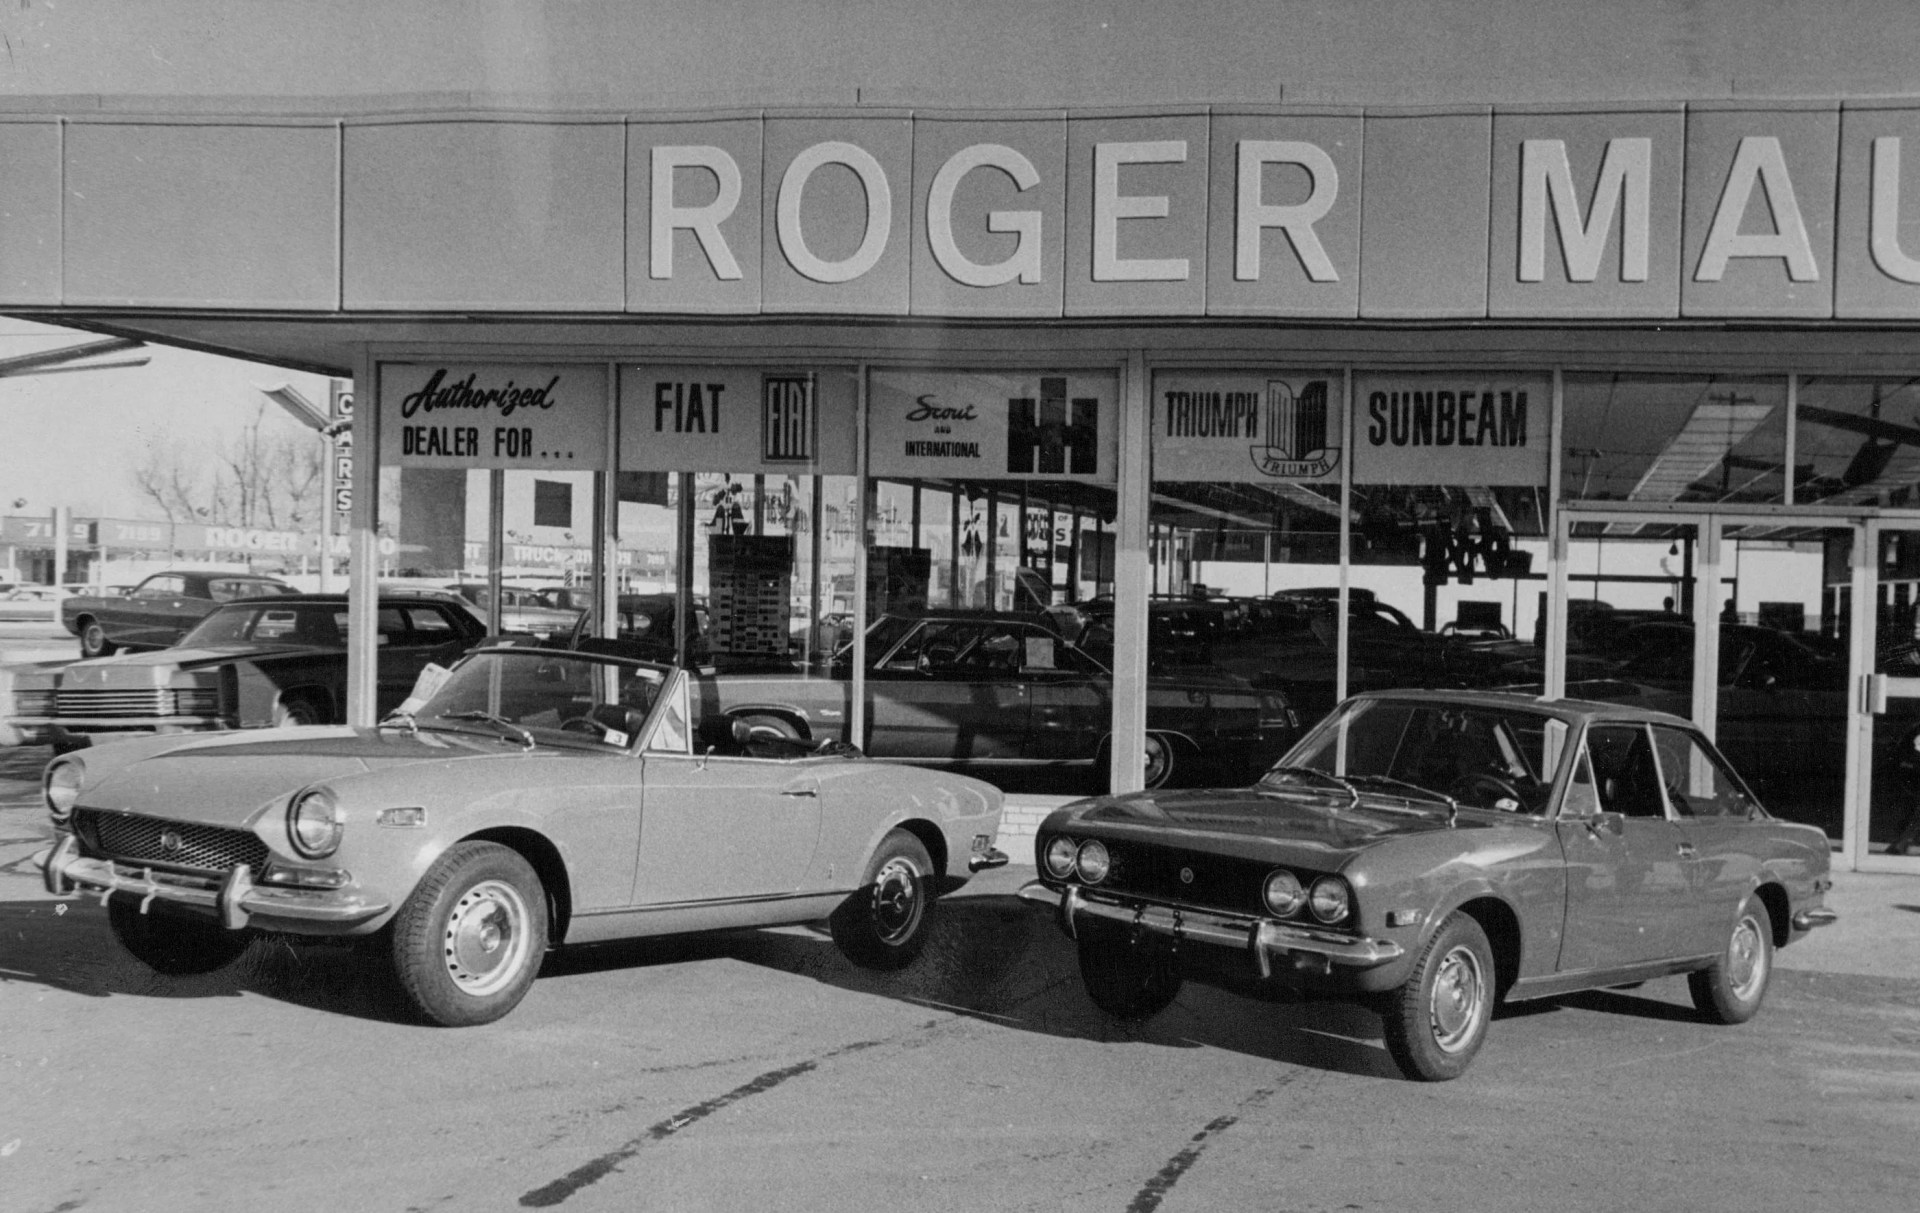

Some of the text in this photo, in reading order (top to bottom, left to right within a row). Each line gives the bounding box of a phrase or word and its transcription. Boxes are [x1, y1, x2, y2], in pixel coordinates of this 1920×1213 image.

[649, 138, 1343, 287] ROGER
[402, 368, 560, 419] Authorized
[655, 382, 725, 433] FIAT
[905, 394, 979, 421] Scout
[1164, 391, 1259, 438] TRIUMPH
[403, 425, 479, 457] DEALER
[767, 380, 814, 457] FIAT
[934, 426, 951, 434] AND
[1368, 390, 1528, 447] SUNBEAM
[905, 440, 981, 458] INTERNATIONAL
[1262, 457, 1331, 476] TRIUMPH
